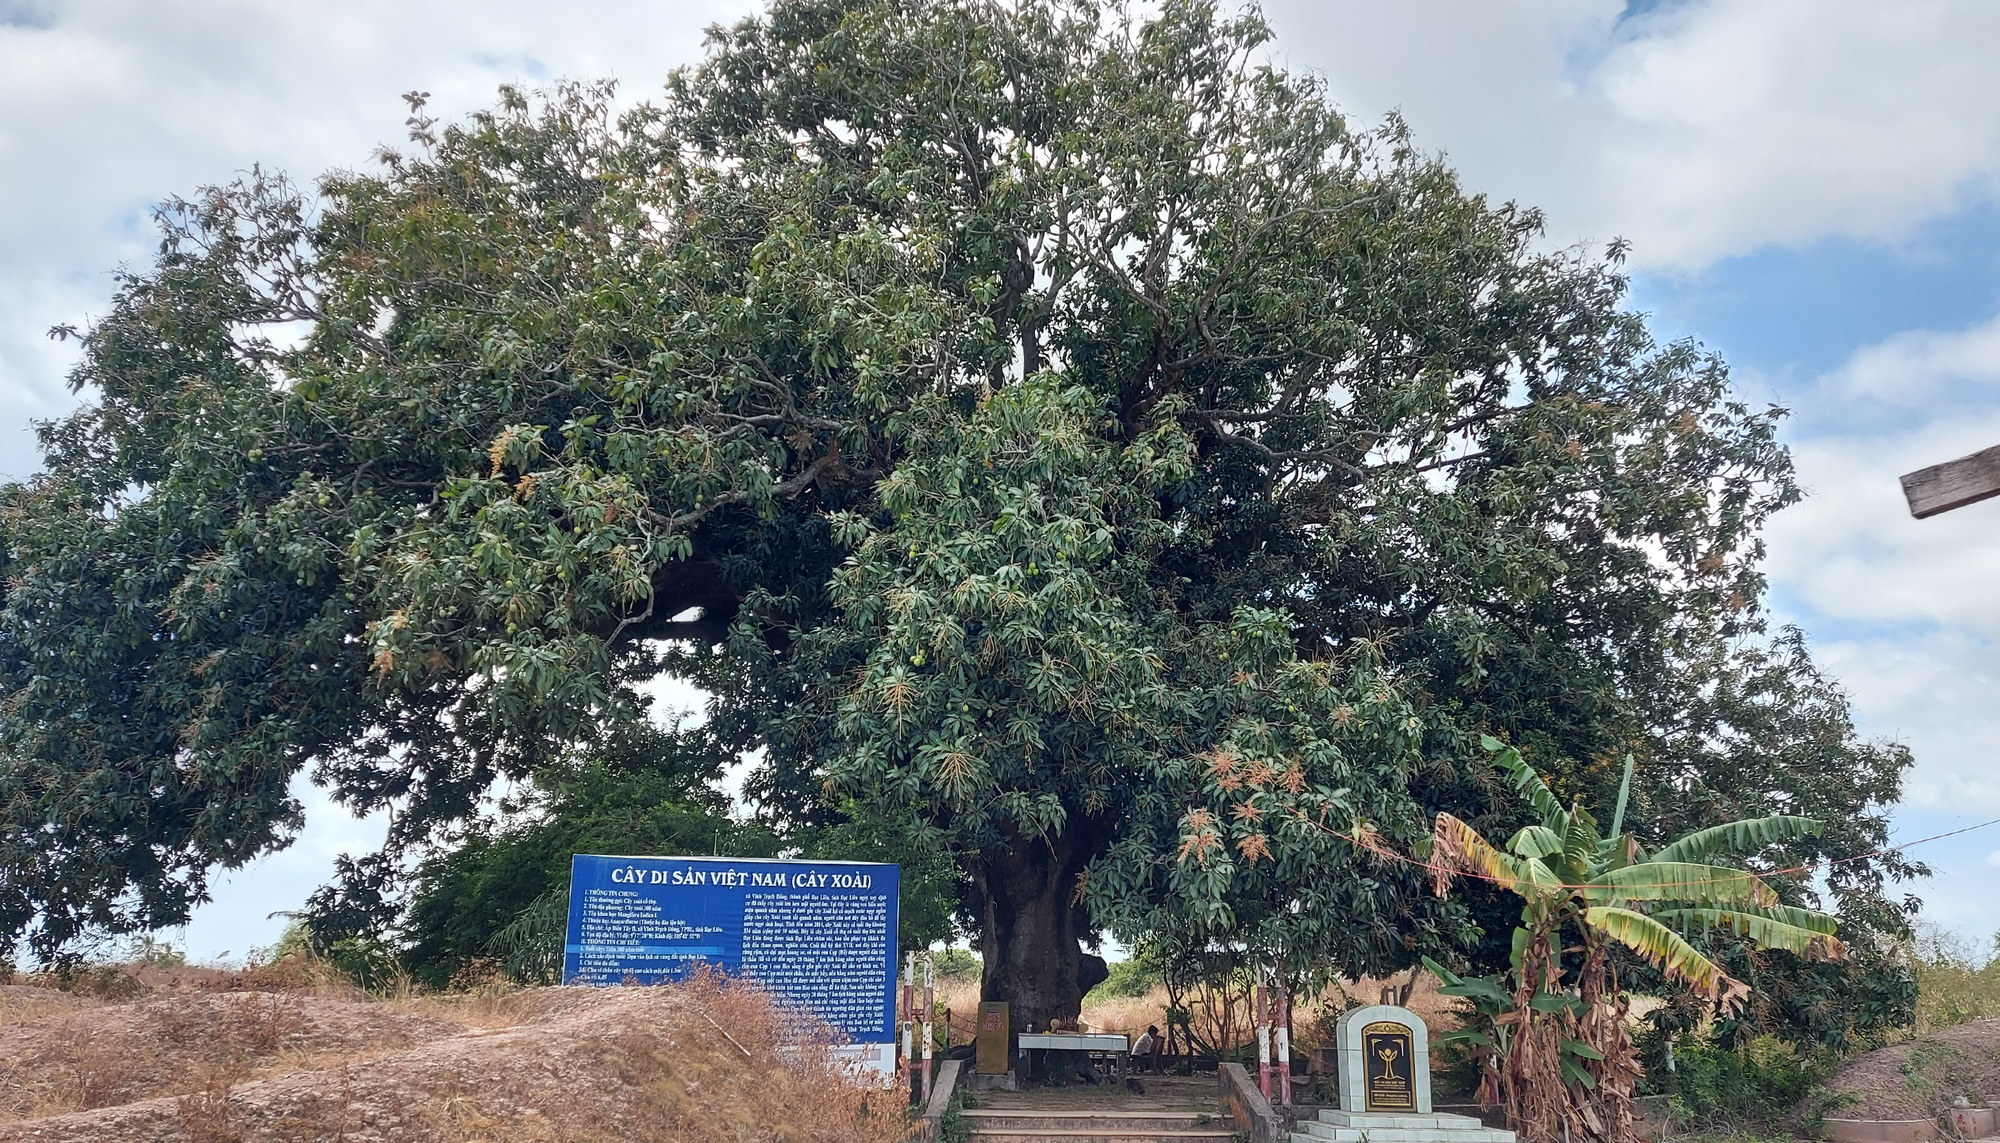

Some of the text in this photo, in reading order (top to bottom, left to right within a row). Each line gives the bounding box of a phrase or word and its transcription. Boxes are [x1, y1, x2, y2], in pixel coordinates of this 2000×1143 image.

[611, 866, 872, 890] CÂY DI SẢN VIỆT NAM (CÂY XOÀI)
